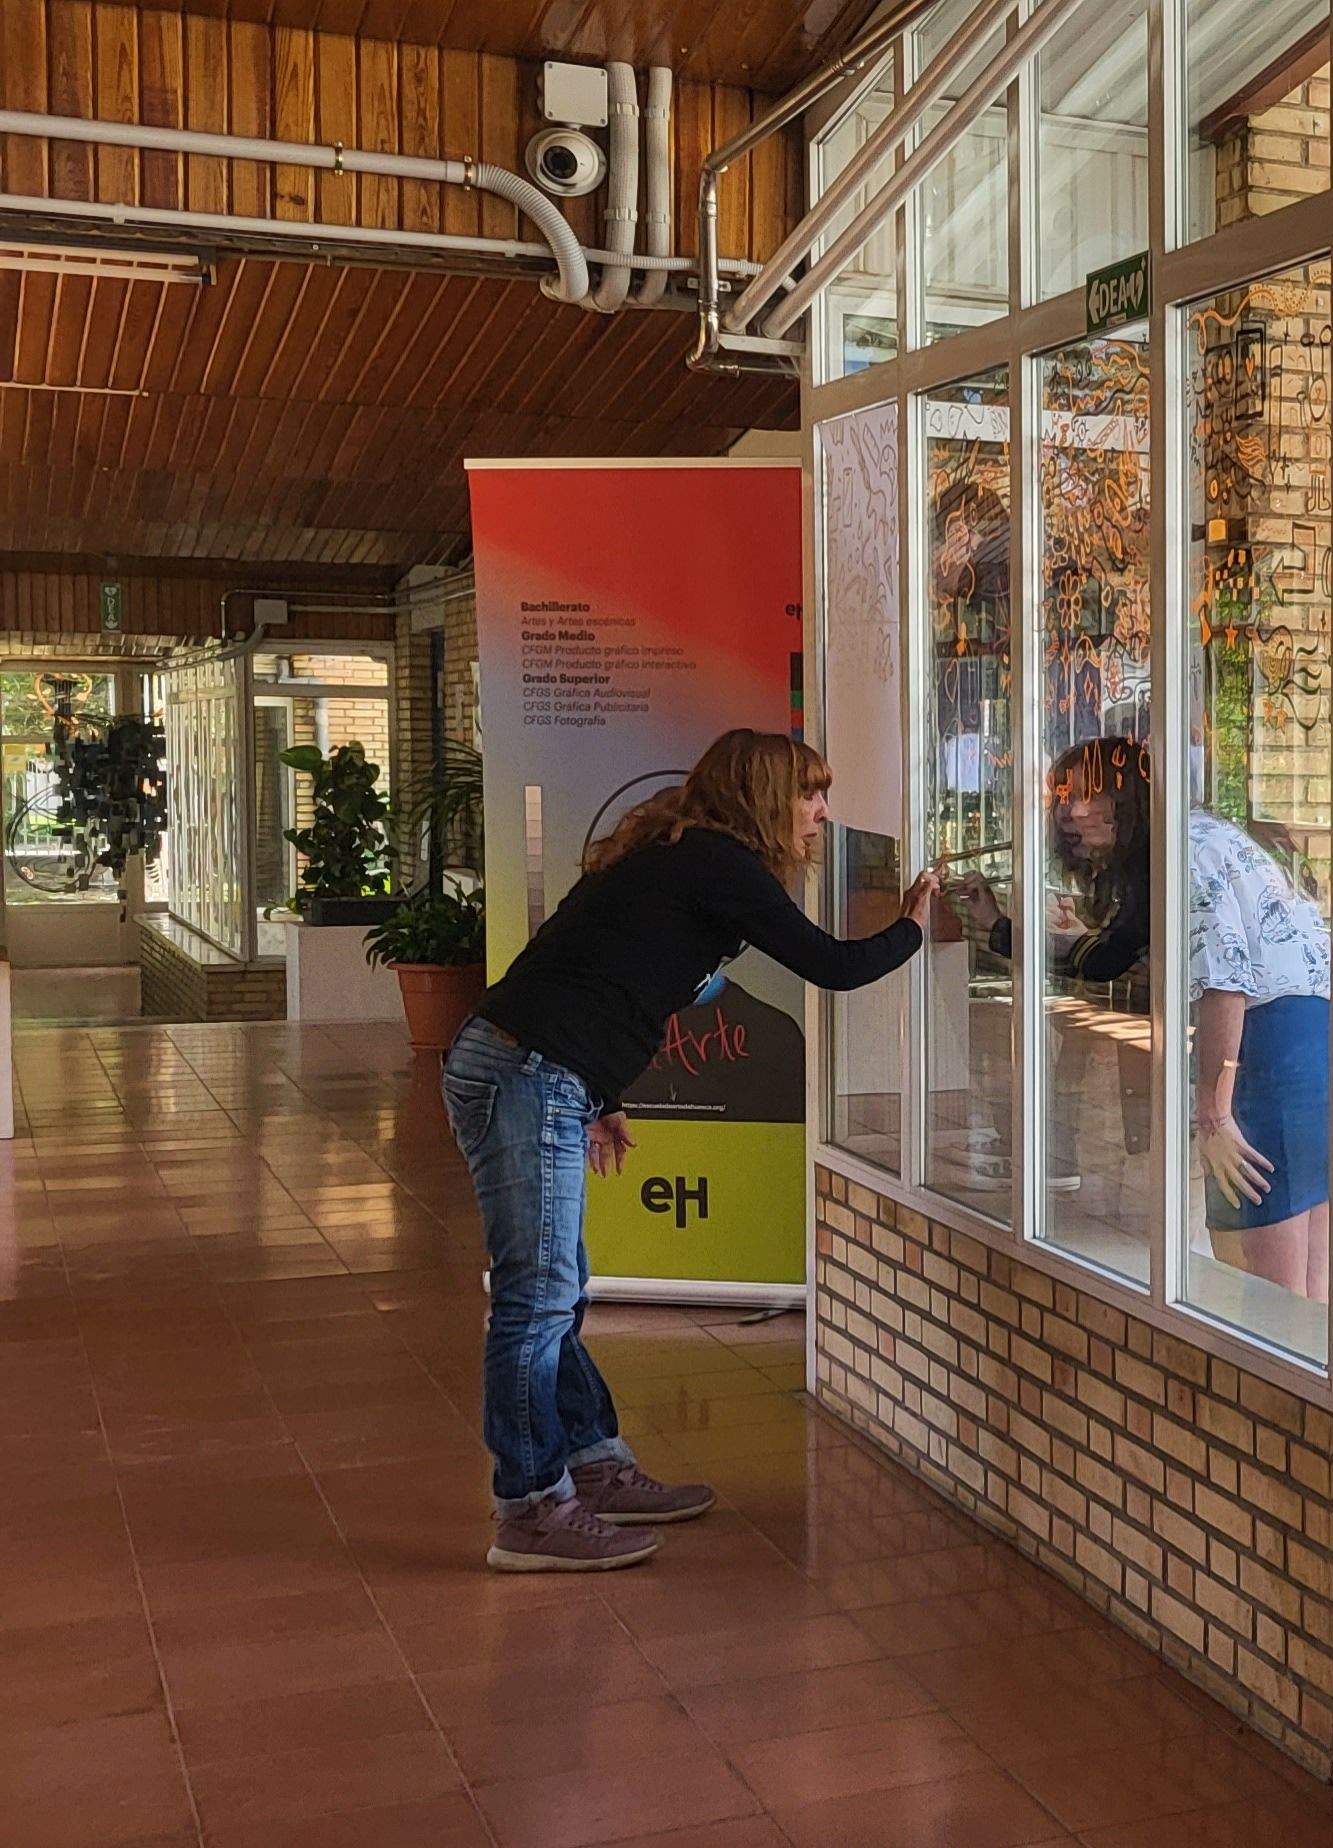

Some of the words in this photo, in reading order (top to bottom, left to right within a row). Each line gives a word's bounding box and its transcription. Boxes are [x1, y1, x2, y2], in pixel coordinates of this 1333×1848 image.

[1100, 274, 1128, 319] DEA
[520, 601, 590, 612] Bachillerato
[521, 617, 546, 626] Artes
[557, 617, 584, 626] Artes
[521, 631, 556, 641] Grado
[558, 631, 596, 641] Medio
[521, 645, 552, 655] CFGM
[555, 645, 601, 656] Producto
[522, 659, 553, 669] CFGM
[555, 659, 602, 669] Producto
[642, 659, 697, 670] interactivo
[522, 673, 557, 684] Grado
[559, 673, 611, 686] Superior
[523, 688, 551, 698] CFGS
[593, 688, 651, 698] Audiovisual
[523, 701, 552, 712] CFGS
[593, 701, 650, 712] Publicitaria
[523, 715, 552, 726] CFGS
[661, 1006, 751, 1076] Arte
[640, 1176, 709, 1229] eH
